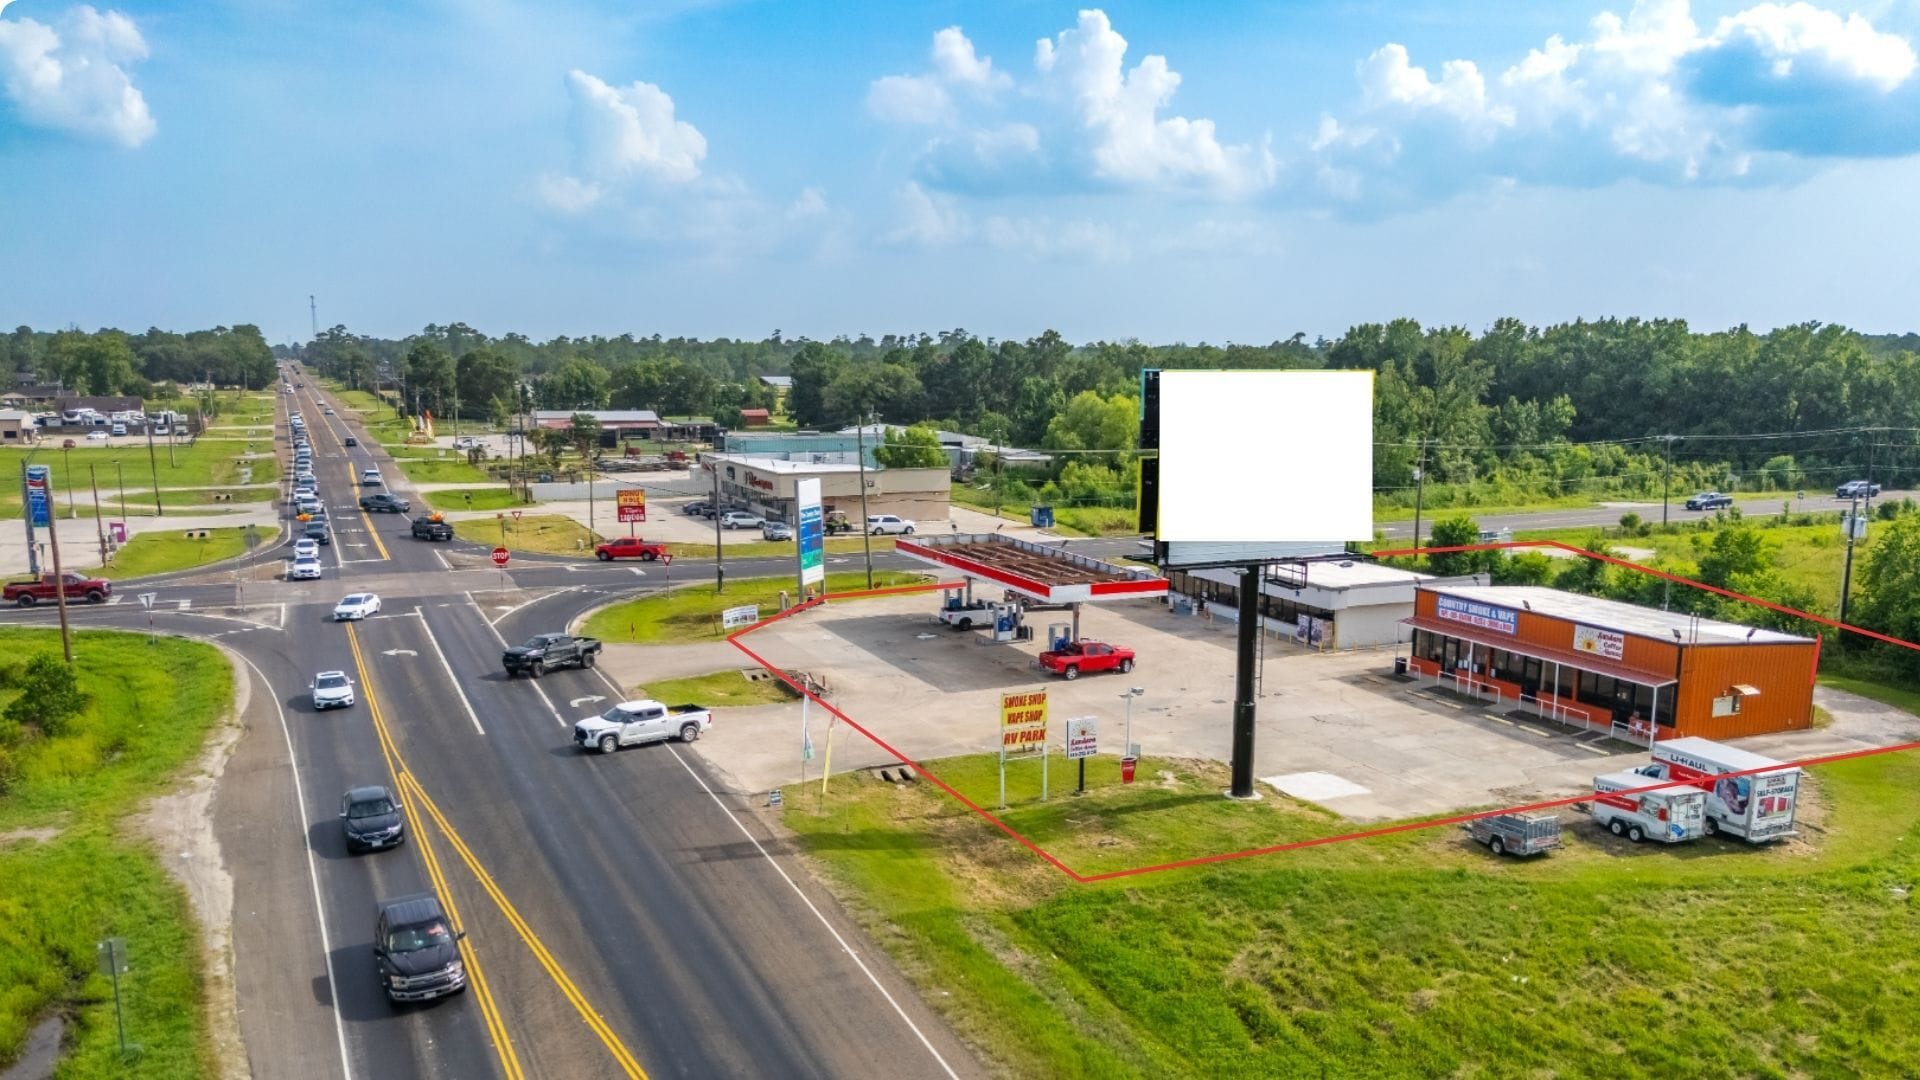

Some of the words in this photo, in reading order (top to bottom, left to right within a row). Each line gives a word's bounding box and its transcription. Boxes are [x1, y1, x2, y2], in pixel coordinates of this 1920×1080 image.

[492, 552, 509, 560] STOP
[1438, 597, 1467, 612] COUNTRY
[1468, 604, 1490, 617] SMOKE
[1497, 610, 1515, 622] VAPE
[1004, 695, 1027, 708] SMOKE
[1028, 693, 1047, 705] SHOP
[1007, 711, 1024, 725] VAPE
[1025, 709, 1043, 722] SHOP
[1004, 732, 1018, 745] RV
[1019, 729, 1046, 743] PARK
[1670, 754, 1708, 772] U-HAUL
